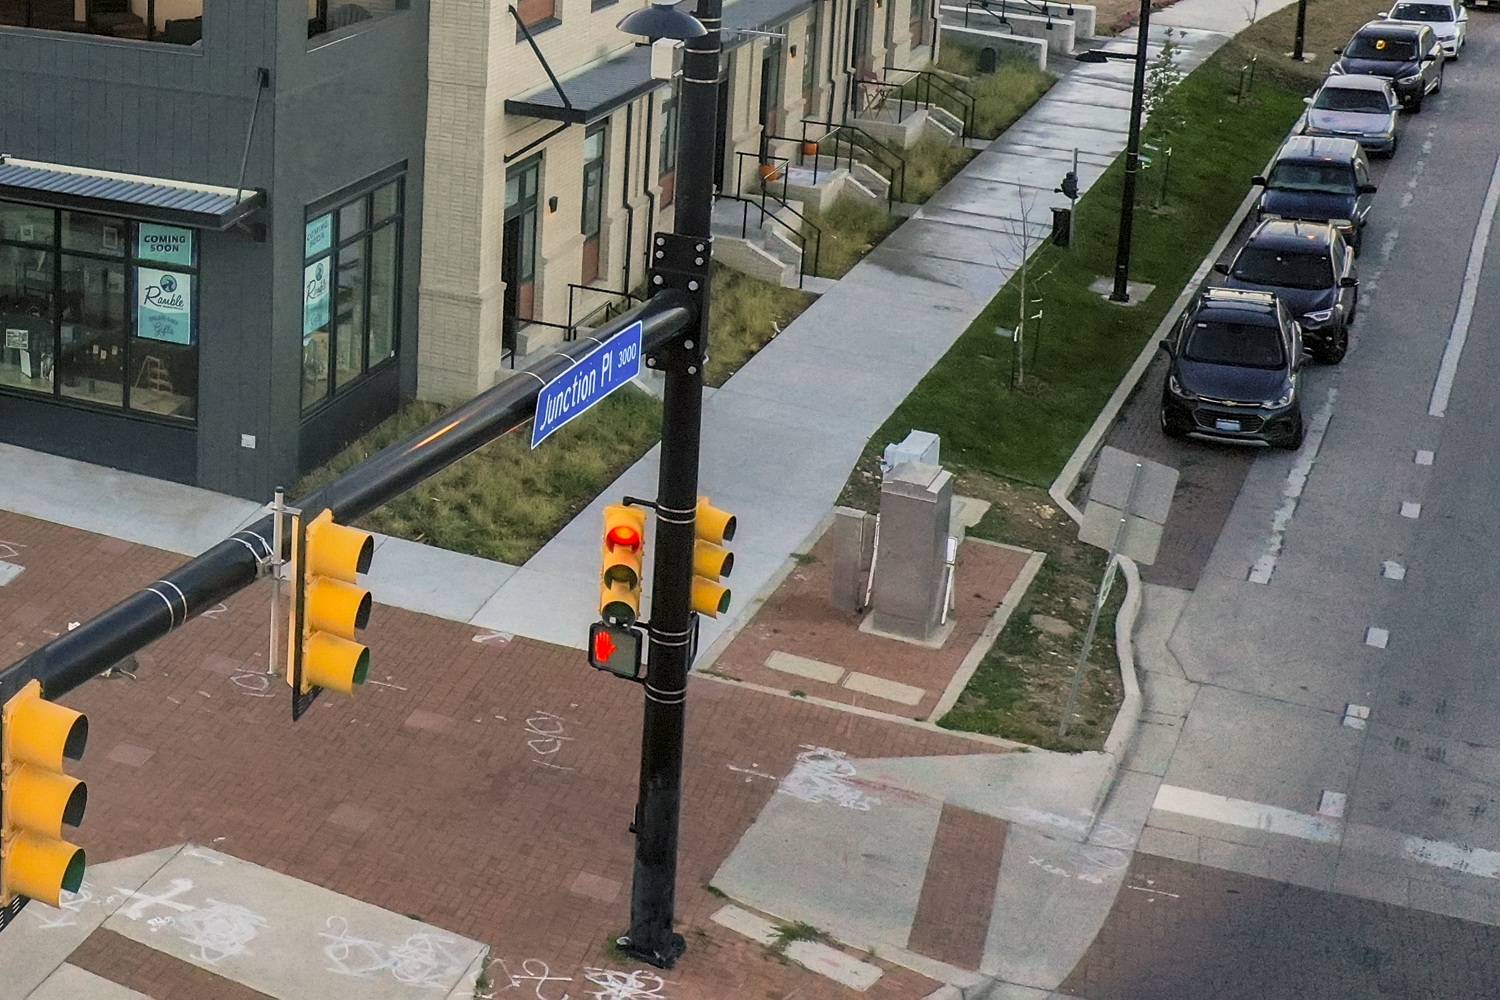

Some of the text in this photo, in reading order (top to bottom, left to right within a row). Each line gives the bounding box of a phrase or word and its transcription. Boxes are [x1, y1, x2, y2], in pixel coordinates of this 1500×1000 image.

[144, 234, 186, 244] COMING
[150, 244, 180, 253] SOON
[143, 285, 185, 308] Ramble
[539, 342, 637, 432] Junction Pl 3000
